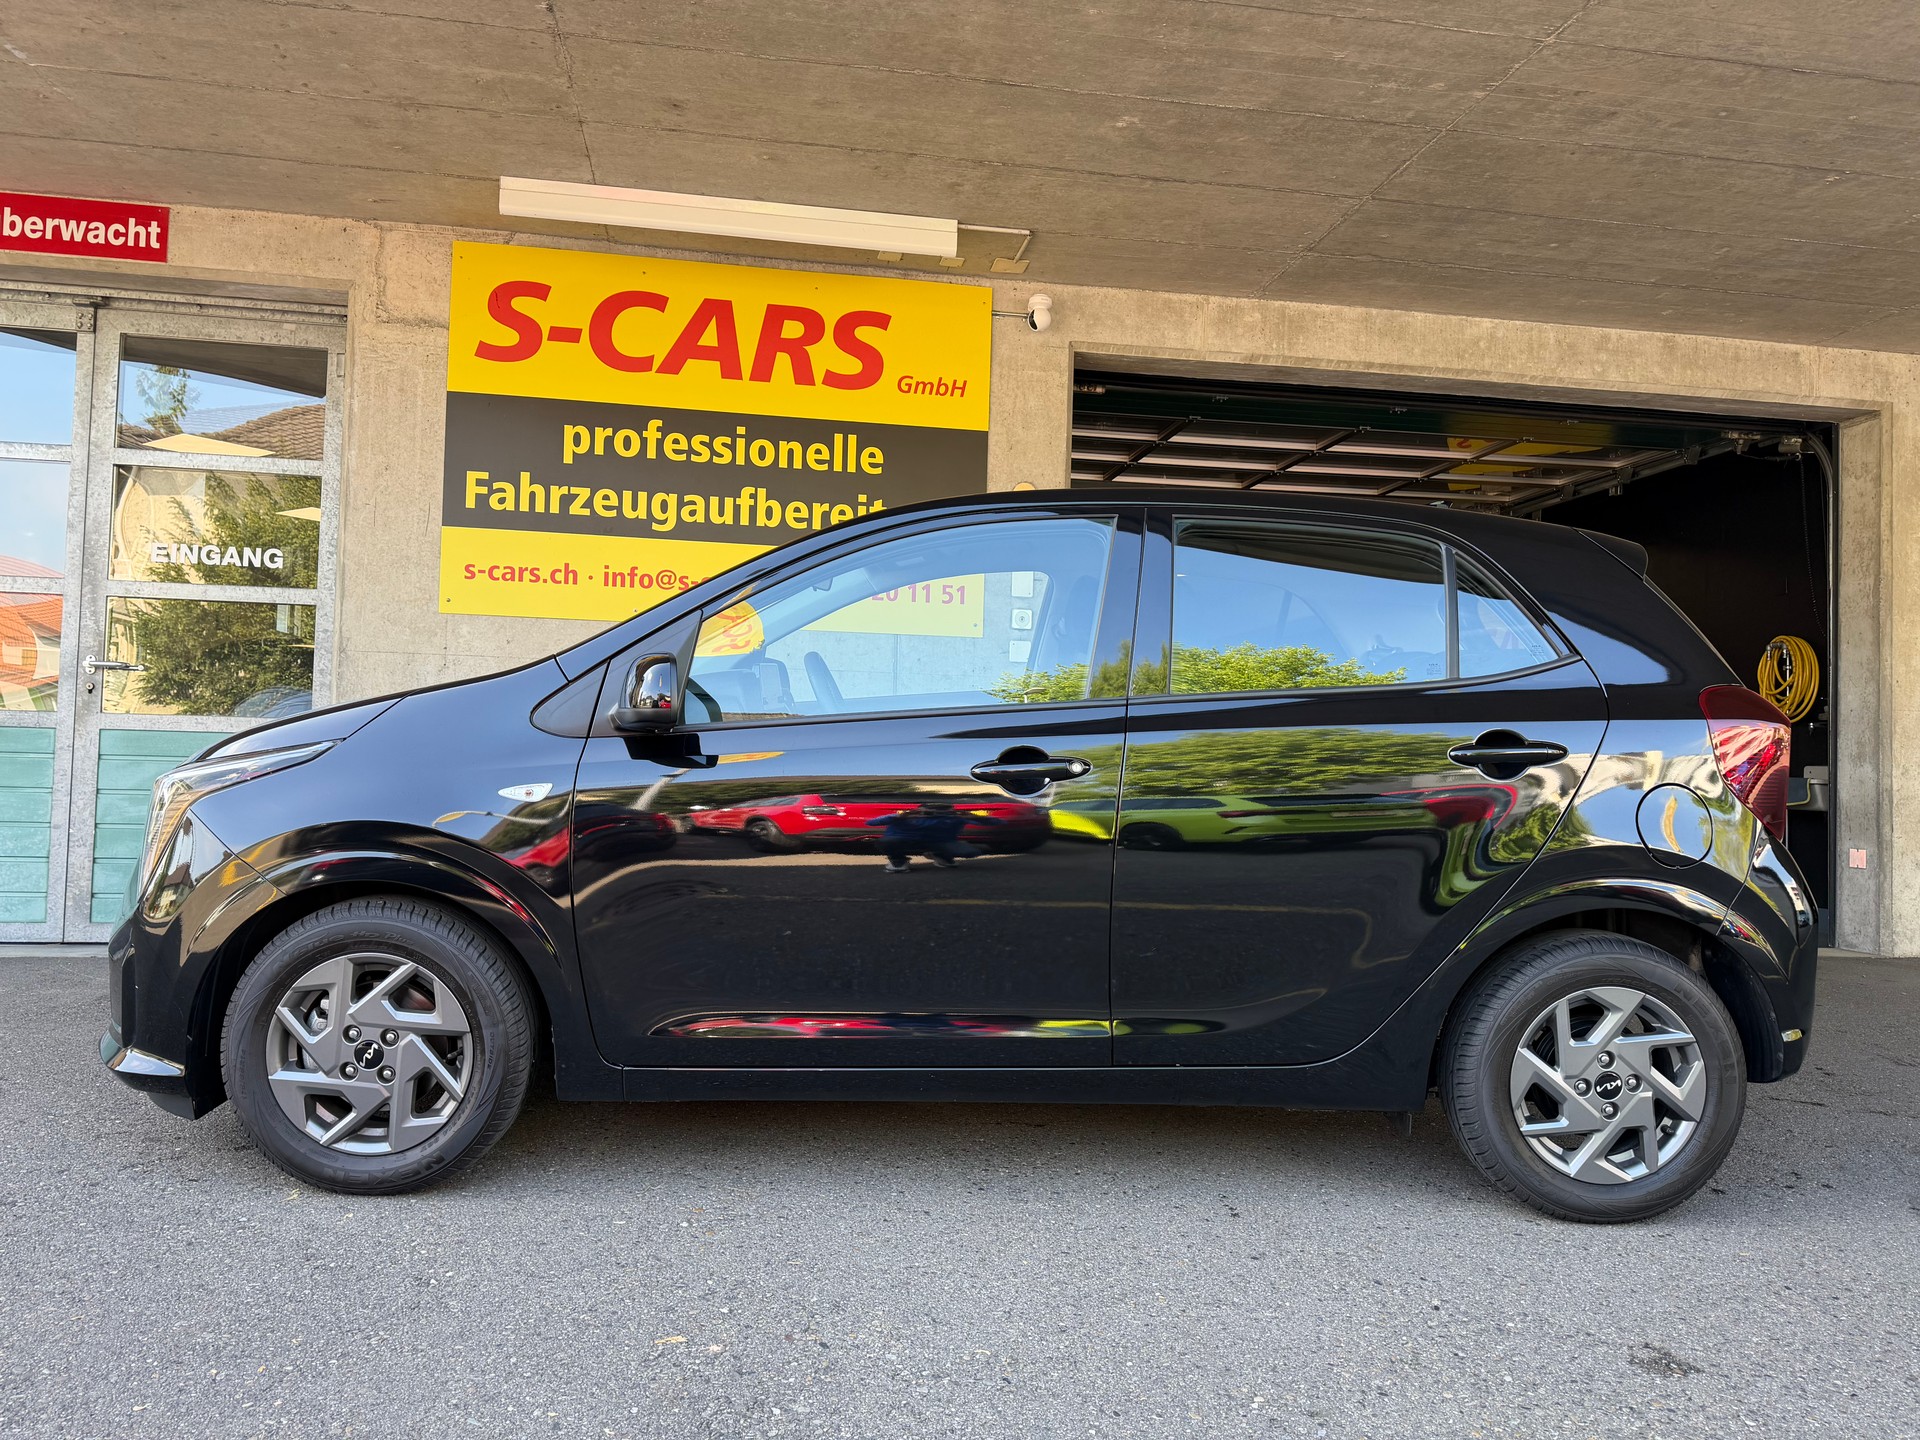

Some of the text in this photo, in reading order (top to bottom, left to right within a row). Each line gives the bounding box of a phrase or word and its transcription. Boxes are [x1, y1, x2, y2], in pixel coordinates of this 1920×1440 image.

[0, 206, 161, 249] berwacht
[474, 280, 968, 398] S-CARS GmbH
[563, 419, 884, 475] professionelle
[151, 542, 284, 569] EINGANG
[463, 559, 579, 587] s-cars.ch
[907, 583, 931, 603] 11
[941, 584, 966, 605] 51
